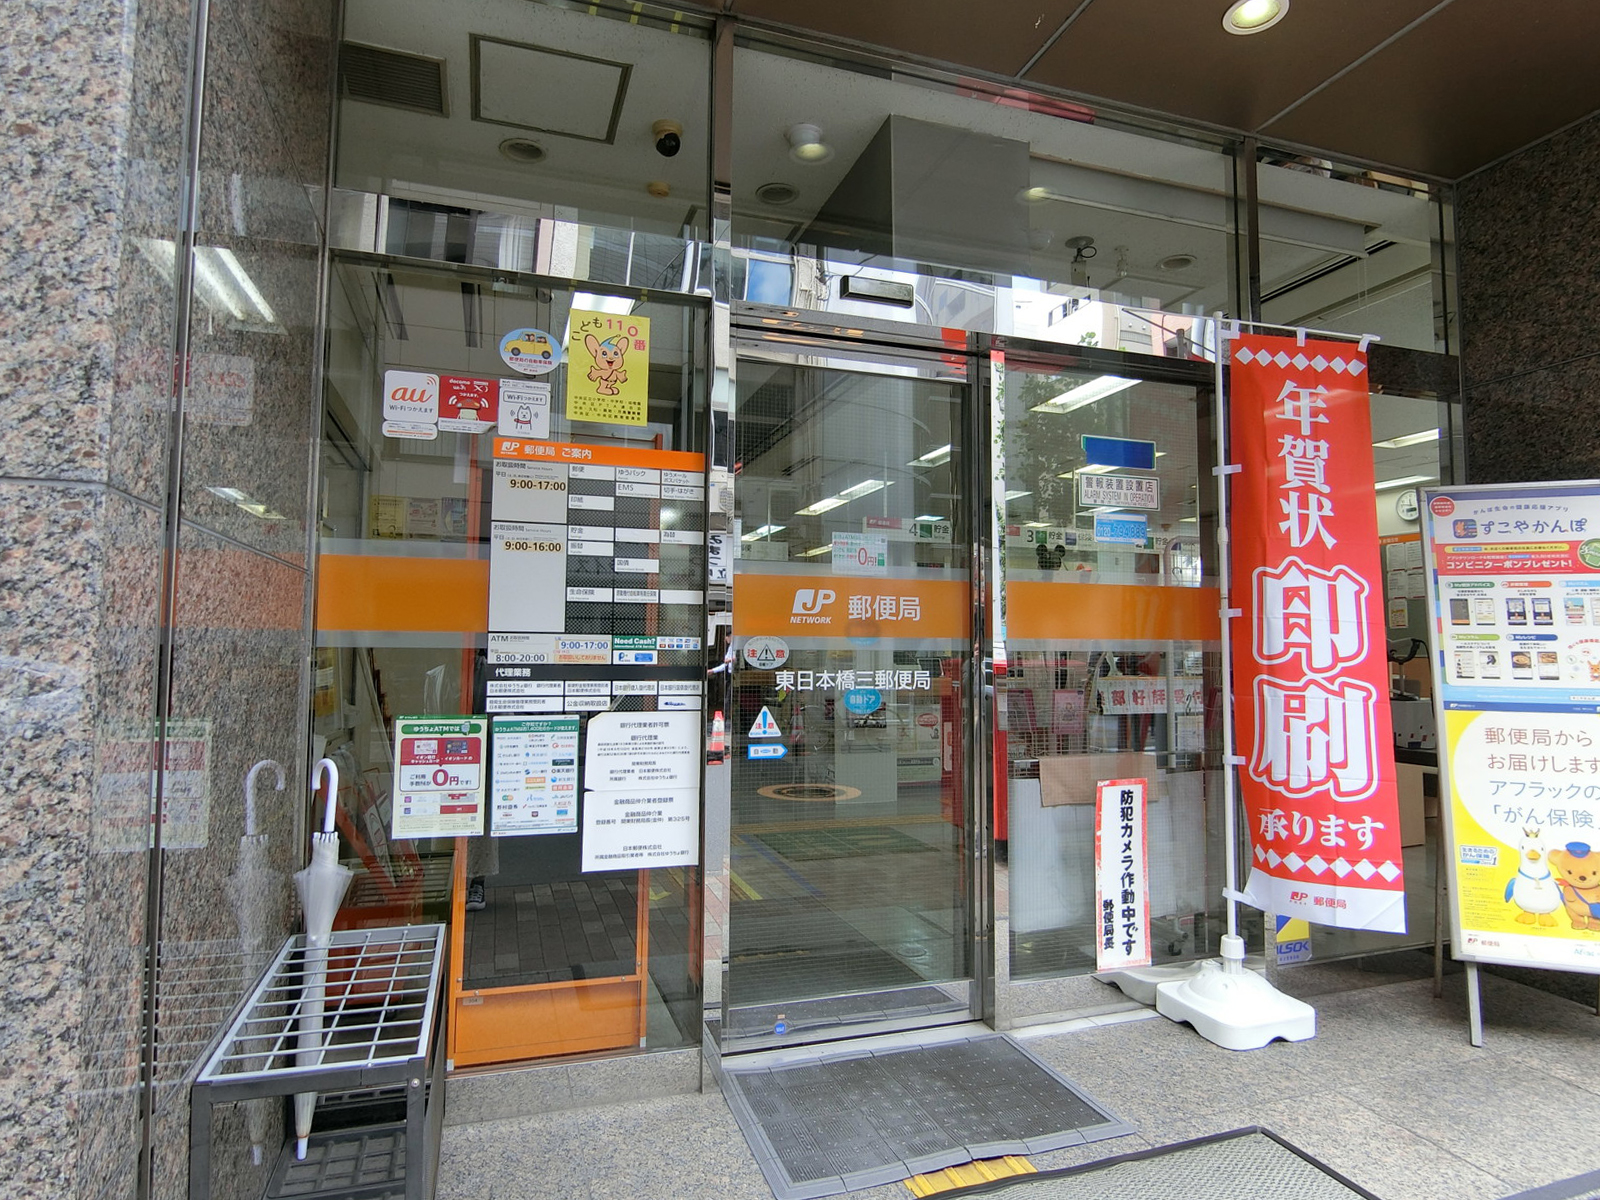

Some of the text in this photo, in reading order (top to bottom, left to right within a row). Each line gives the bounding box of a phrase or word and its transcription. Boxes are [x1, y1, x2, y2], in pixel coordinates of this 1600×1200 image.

[391, 386, 433, 404] au
[524, 444, 593, 460] 郵便局 ご案内
[571, 465, 585, 474] 郵便
[1276, 379, 1337, 550] 年賀状
[510, 479, 566, 491] 9:00-17:00
[618, 484, 634, 492] EMS
[1085, 476, 1154, 493] 警報装置設置店
[1084, 489, 1155, 503] ALARM SYSTEM IN OPERATION
[1473, 504, 1569, 516] かんぽ生命の健康応援アプリ
[570, 526, 584, 535] 貯金
[909, 523, 919, 536] 4
[933, 524, 950, 535] 貯金
[1480, 517, 1588, 535] すこやかんぽ
[1027, 529, 1034, 543] 3
[1049, 531, 1063, 540] 貯金
[505, 541, 561, 552] 9:00-16:00
[1446, 559, 1573, 569] コンビニクーポンプレゼント!
[569, 588, 595, 596] 生命保険
[791, 588, 836, 615] JP
[848, 595, 921, 622] 郵便局
[790, 616, 832, 624] NETWORK
[561, 641, 608, 650] 9:00-17:00
[634, 637, 656, 645] Cash?
[495, 653, 545, 663] 8:00-20:00
[495, 668, 531, 677] 代理業務
[1252, 557, 1376, 800] 印刷
[774, 670, 931, 691] 東日本橋三郵便局
[413, 725, 460, 733] ゆうちょATMでは
[1484, 727, 1592, 747] 郵便局から
[1487, 754, 1600, 774] お届けします
[1489, 780, 1600, 800] アフラックの
[624, 810, 663, 818] 金融商品仲介業
[1259, 807, 1385, 850] 承ります
[1119, 789, 1139, 956] 防犯カメラ作動中です
[1313, 896, 1347, 909] 郵便局
[1102, 899, 1115, 950] 郵便局長
